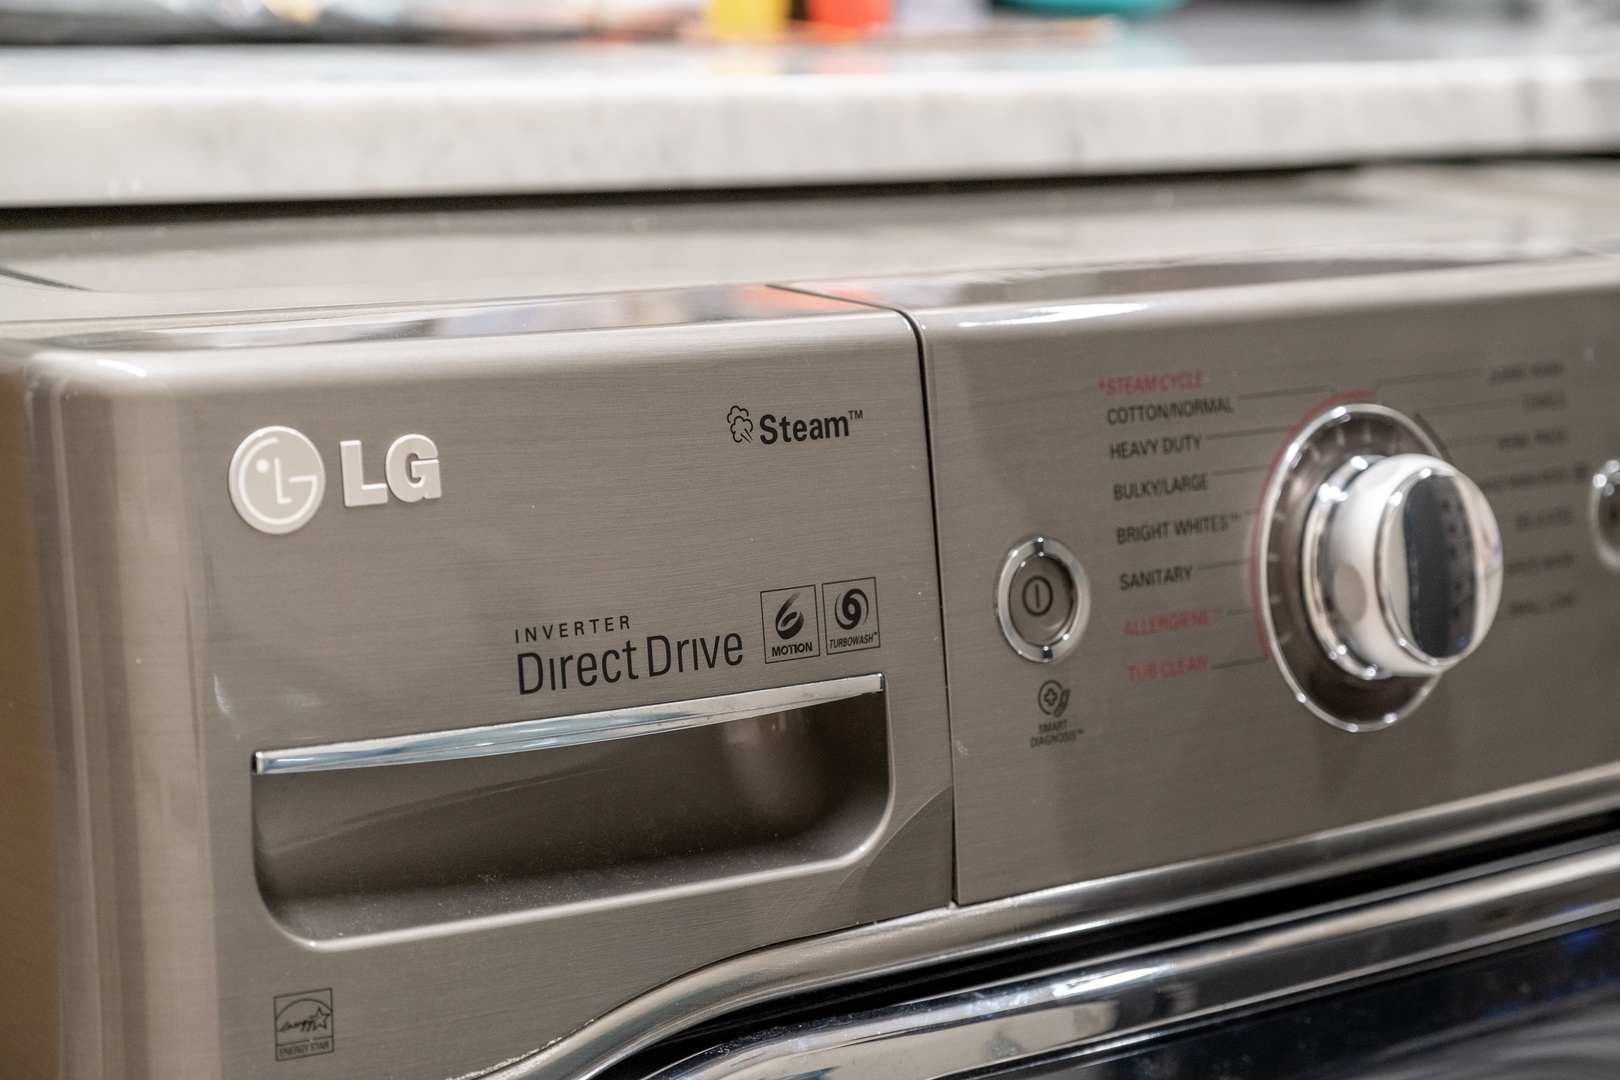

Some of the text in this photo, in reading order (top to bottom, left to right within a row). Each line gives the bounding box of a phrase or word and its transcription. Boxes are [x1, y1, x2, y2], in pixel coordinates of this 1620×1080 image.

[1106, 397, 1234, 426] COTTON/NORMAL
[1109, 433, 1202, 460] HEAVY DUTY
[339, 433, 442, 507] LG
[1112, 472, 1209, 502] BULKY/LARGE
[1116, 521, 1170, 545] BRIGHT
[1119, 565, 1193, 592] SANITARY
[514, 614, 631, 644] INVERTER
[771, 642, 813, 657] MOTION
[516, 632, 744, 695] Direct Drive
[1127, 655, 1208, 682] TUB CLEAN
[1038, 719, 1067, 735] SMART
[280, 1041, 329, 1057] ENERGY STAR
